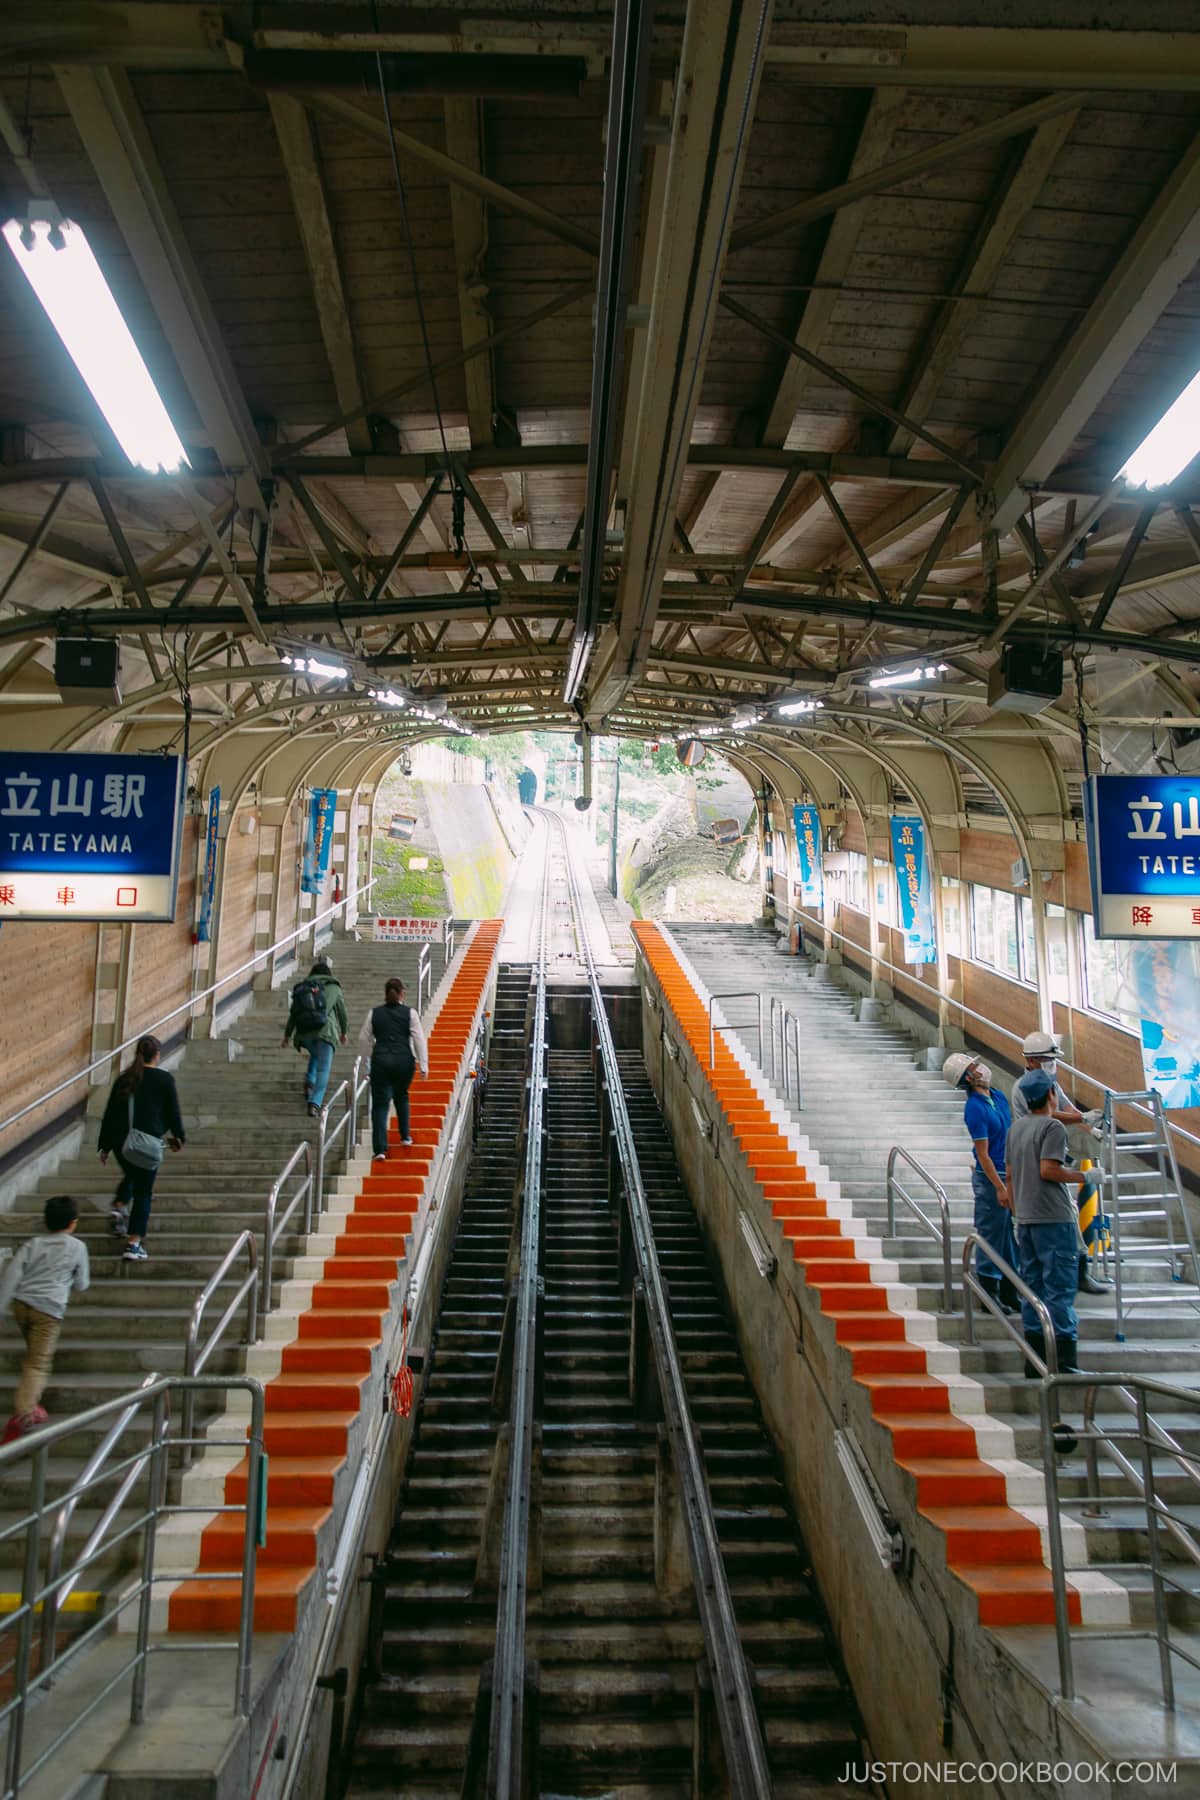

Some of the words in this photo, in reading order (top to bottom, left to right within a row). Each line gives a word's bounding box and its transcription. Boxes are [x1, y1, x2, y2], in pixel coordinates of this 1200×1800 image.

[1, 771, 146, 819] 立山駅
[1127, 795, 1200, 840] 立山
[9, 833, 133, 853] TATEYAMA
[1138, 855, 1200, 875] TATE
